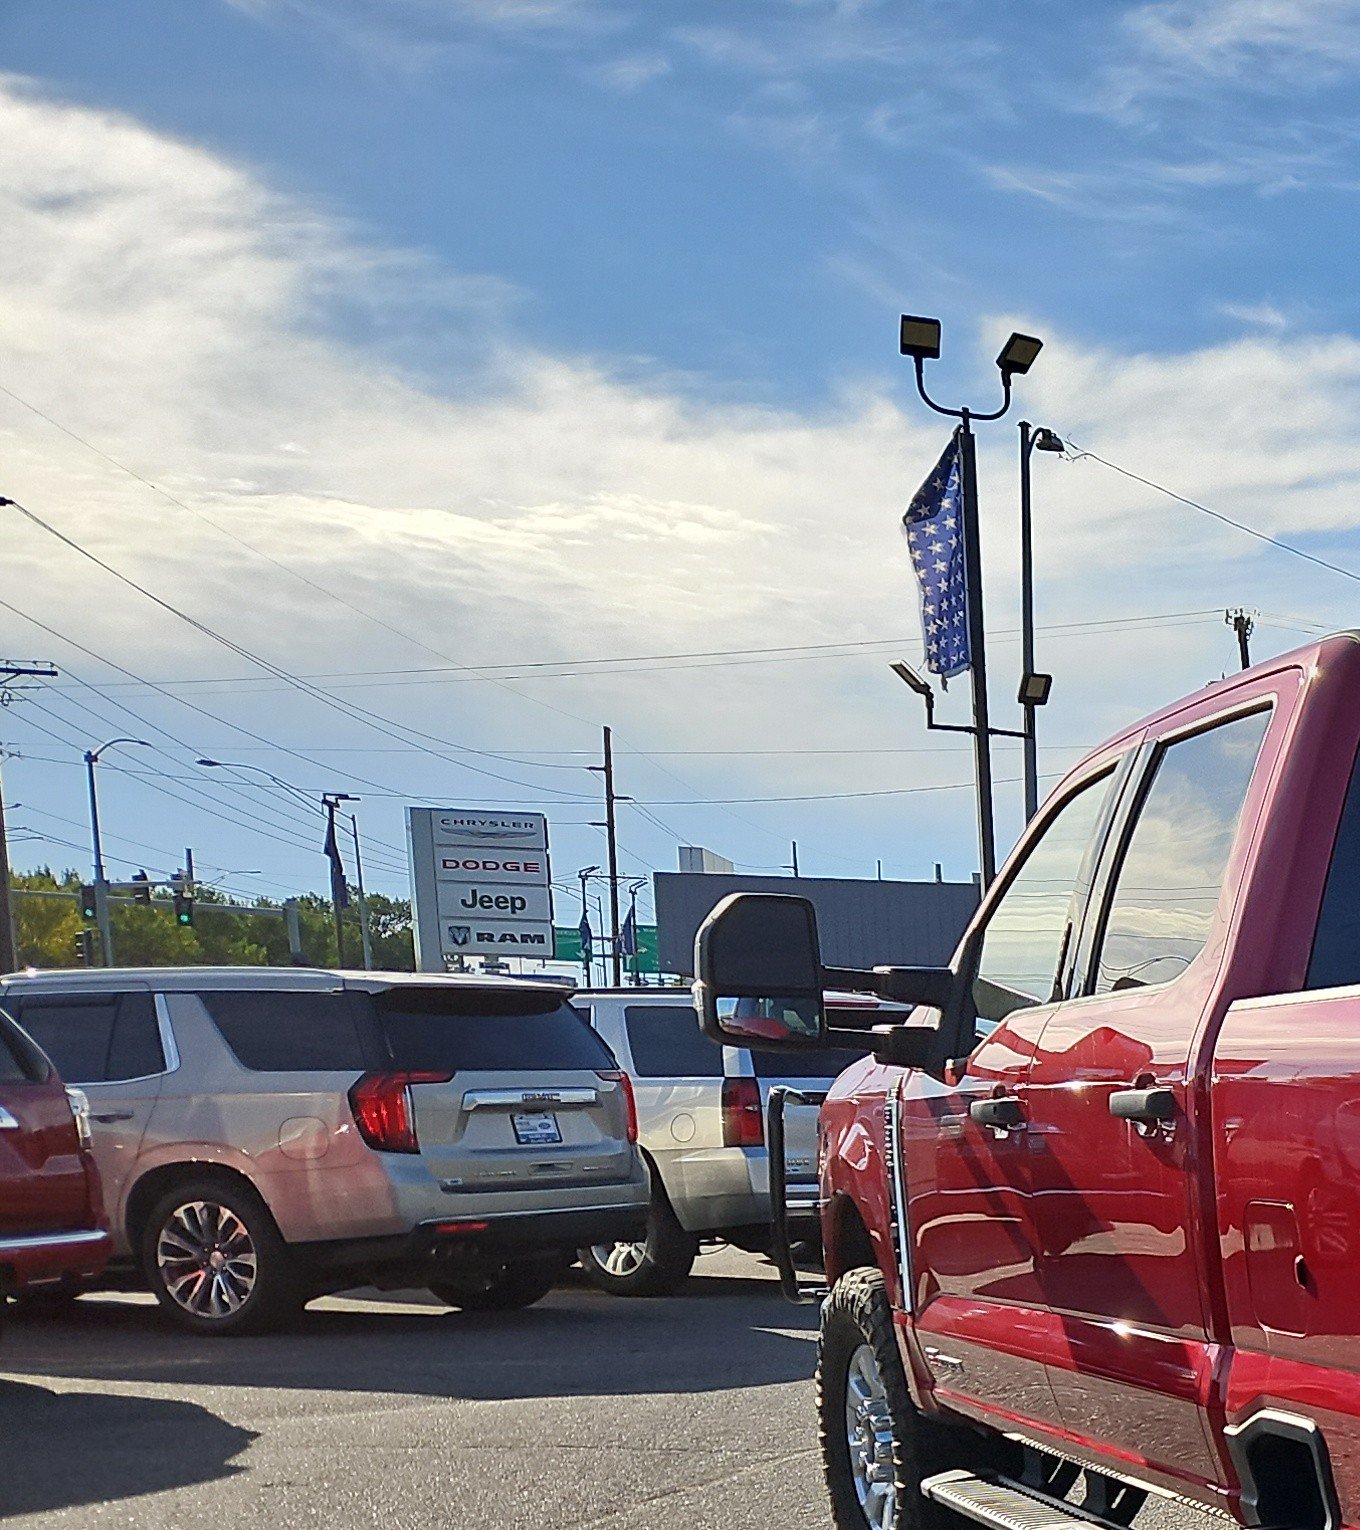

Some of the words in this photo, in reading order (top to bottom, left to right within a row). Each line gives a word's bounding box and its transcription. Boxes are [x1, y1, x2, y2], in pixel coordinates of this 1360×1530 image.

[440, 818, 535, 829] CHRYSLER
[441, 858, 541, 873] DODGE
[460, 888, 527, 914] Jeep
[476, 932, 545, 944] RAM
